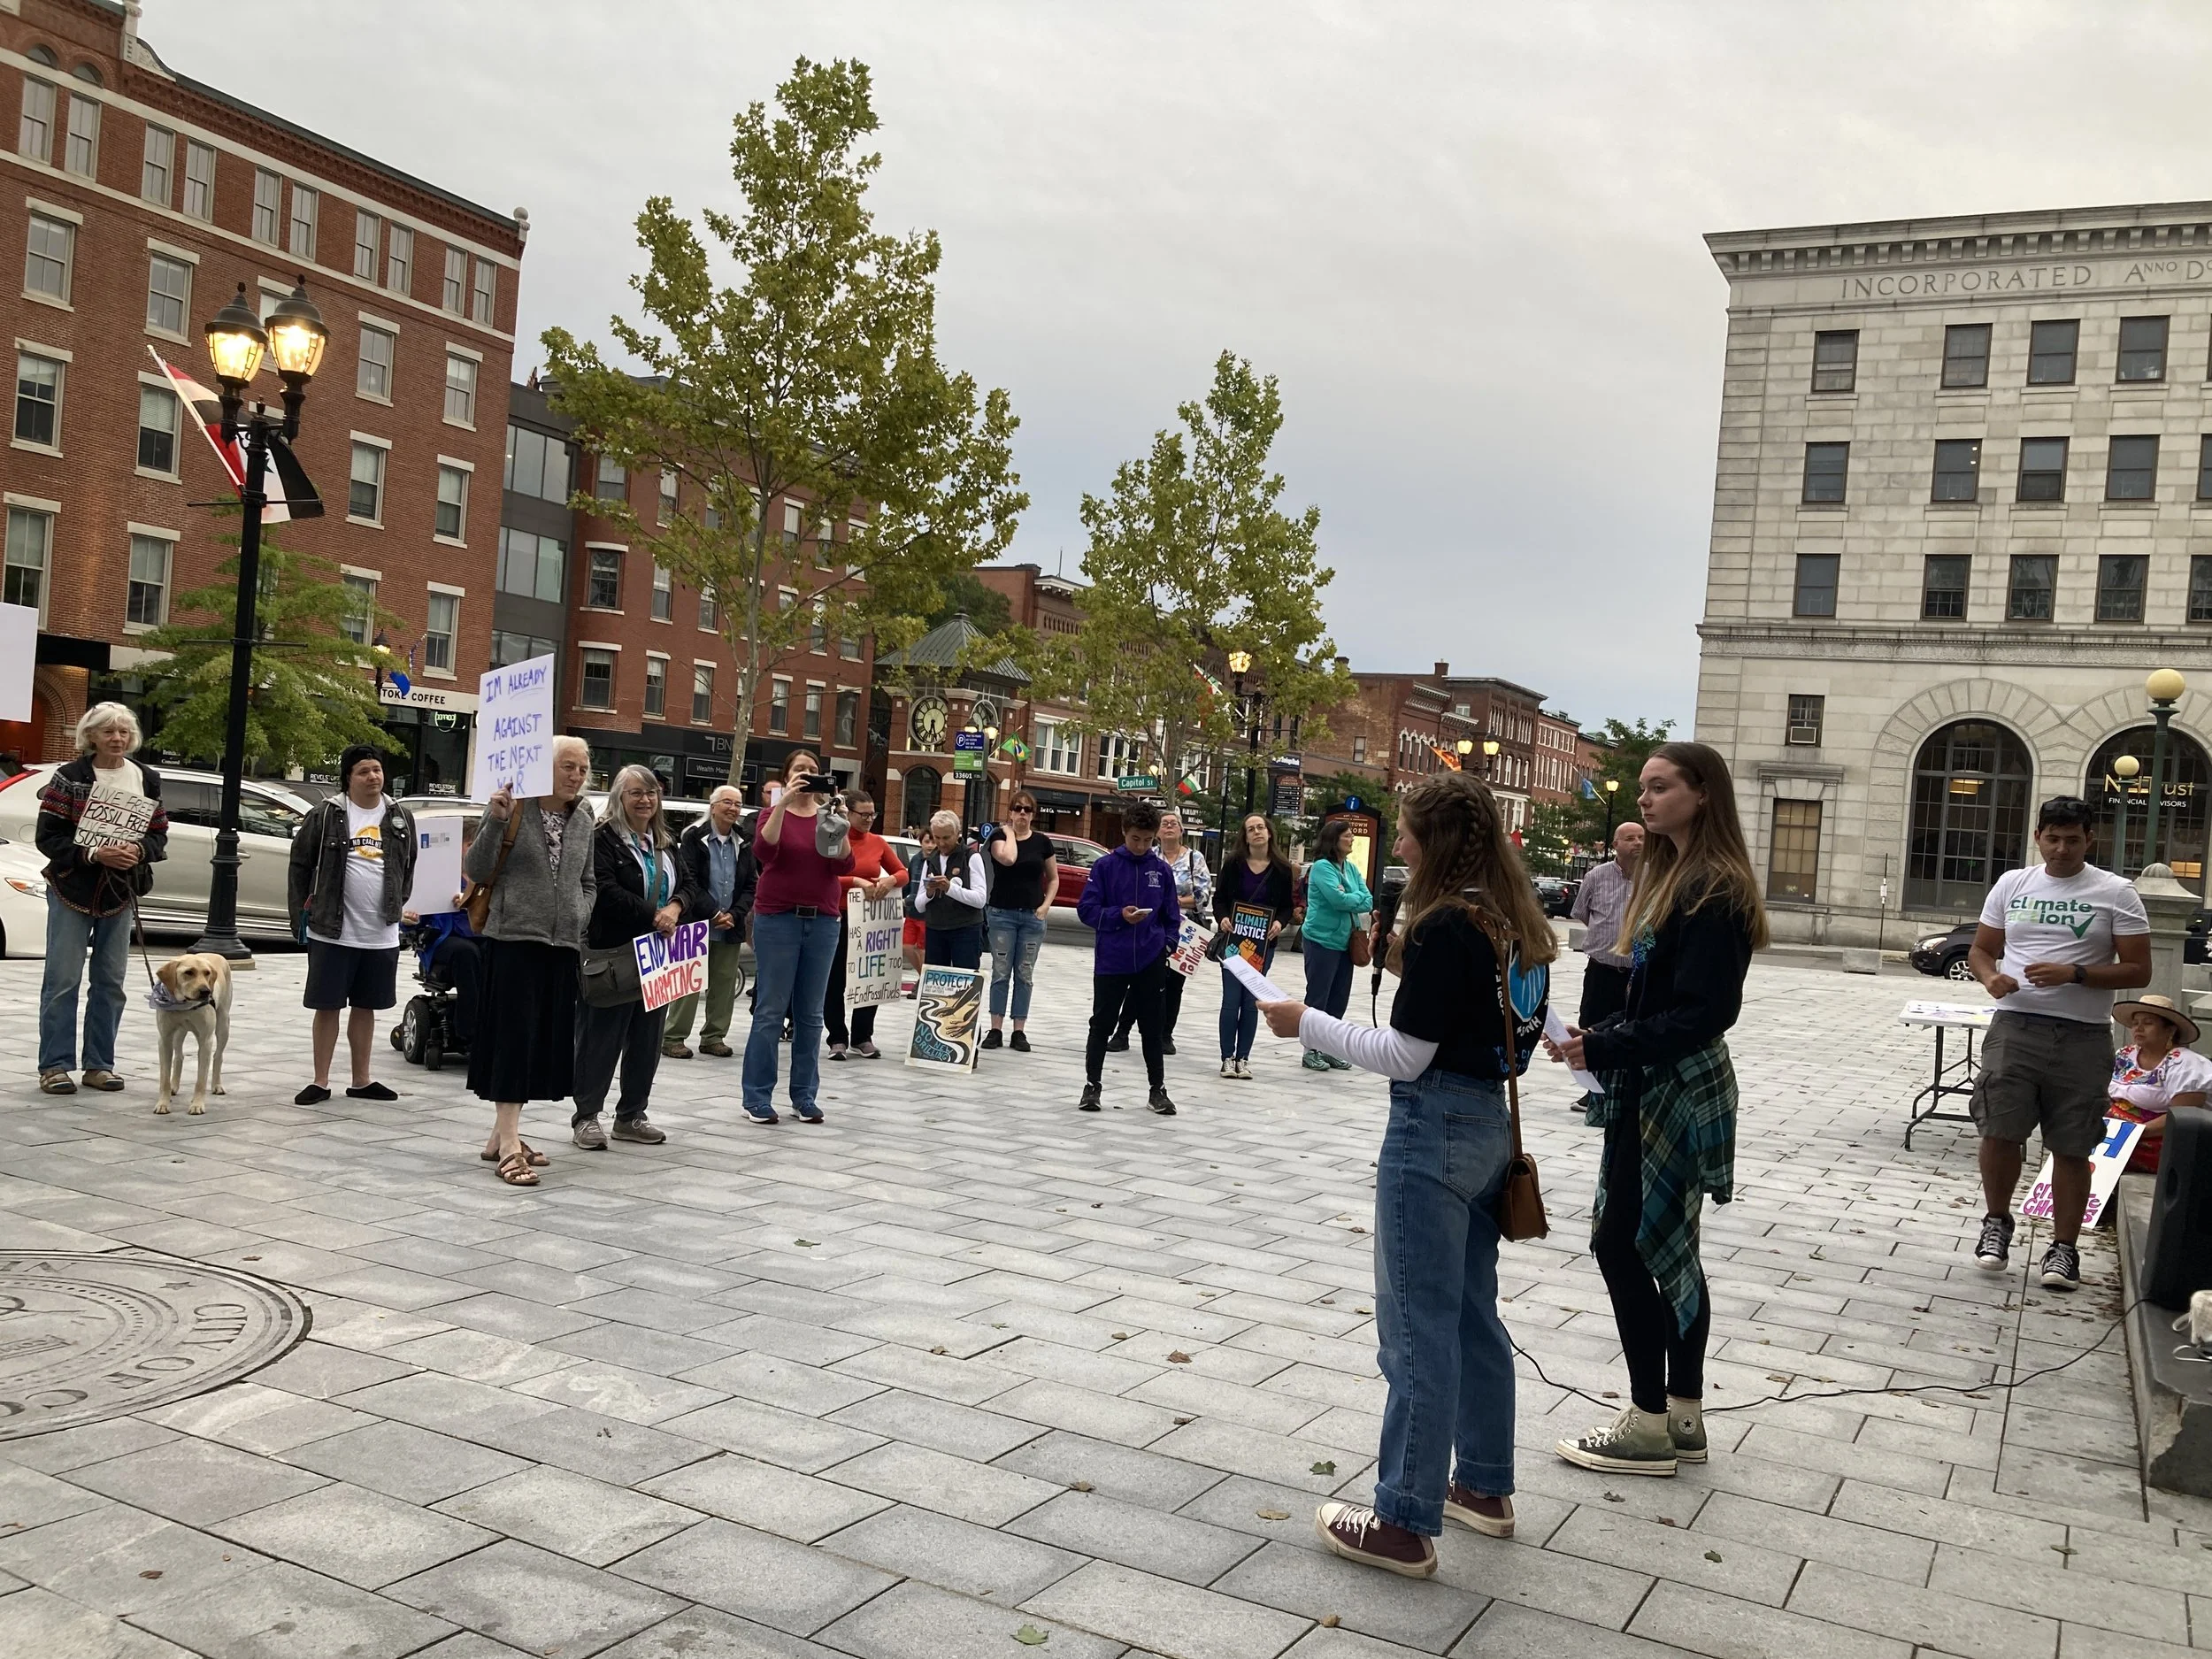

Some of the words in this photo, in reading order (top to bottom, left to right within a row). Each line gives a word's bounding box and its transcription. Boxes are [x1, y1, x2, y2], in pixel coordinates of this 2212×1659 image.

[1841, 264, 2092, 299] INCORPORATED
[508, 665, 547, 695] ALREADY
[411, 693, 445, 704] COFFEE
[494, 713, 541, 741] AGAINST
[488, 750, 505, 772] THE
[510, 744, 543, 770] NEXT
[497, 770, 525, 795] WAR
[1121, 778, 1145, 788] Capitol
[91, 785, 124, 805] LIVE
[126, 795, 155, 817] FREE
[2108, 797, 2147, 806] FINNCIAL
[84, 802, 123, 827] FOSSIL
[126, 812, 149, 833] FREE
[848, 891, 861, 902] THE
[863, 896, 902, 922] FUTURE
[2010, 896, 2093, 912] climate
[849, 926, 862, 939] HAS
[1233, 923, 1267, 941] JUSTICE
[1235, 912, 1269, 929] CLIMATE
[635, 932, 666, 976] END
[667, 921, 707, 964] WAR
[856, 940, 863, 951] A
[865, 927, 901, 953] RIGHT
[848, 962, 856, 973] TO
[858, 954, 887, 979] LIFE
[889, 956, 902, 969] TOO
[642, 960, 703, 1010] WARMING
[847, 981, 901, 1004] #EndFossilFuels
[926, 972, 970, 989] PROTECT
[914, 1036, 949, 1061] DRILLING
[916, 1024, 933, 1041] NO
[934, 1042, 954, 1054] NEW
